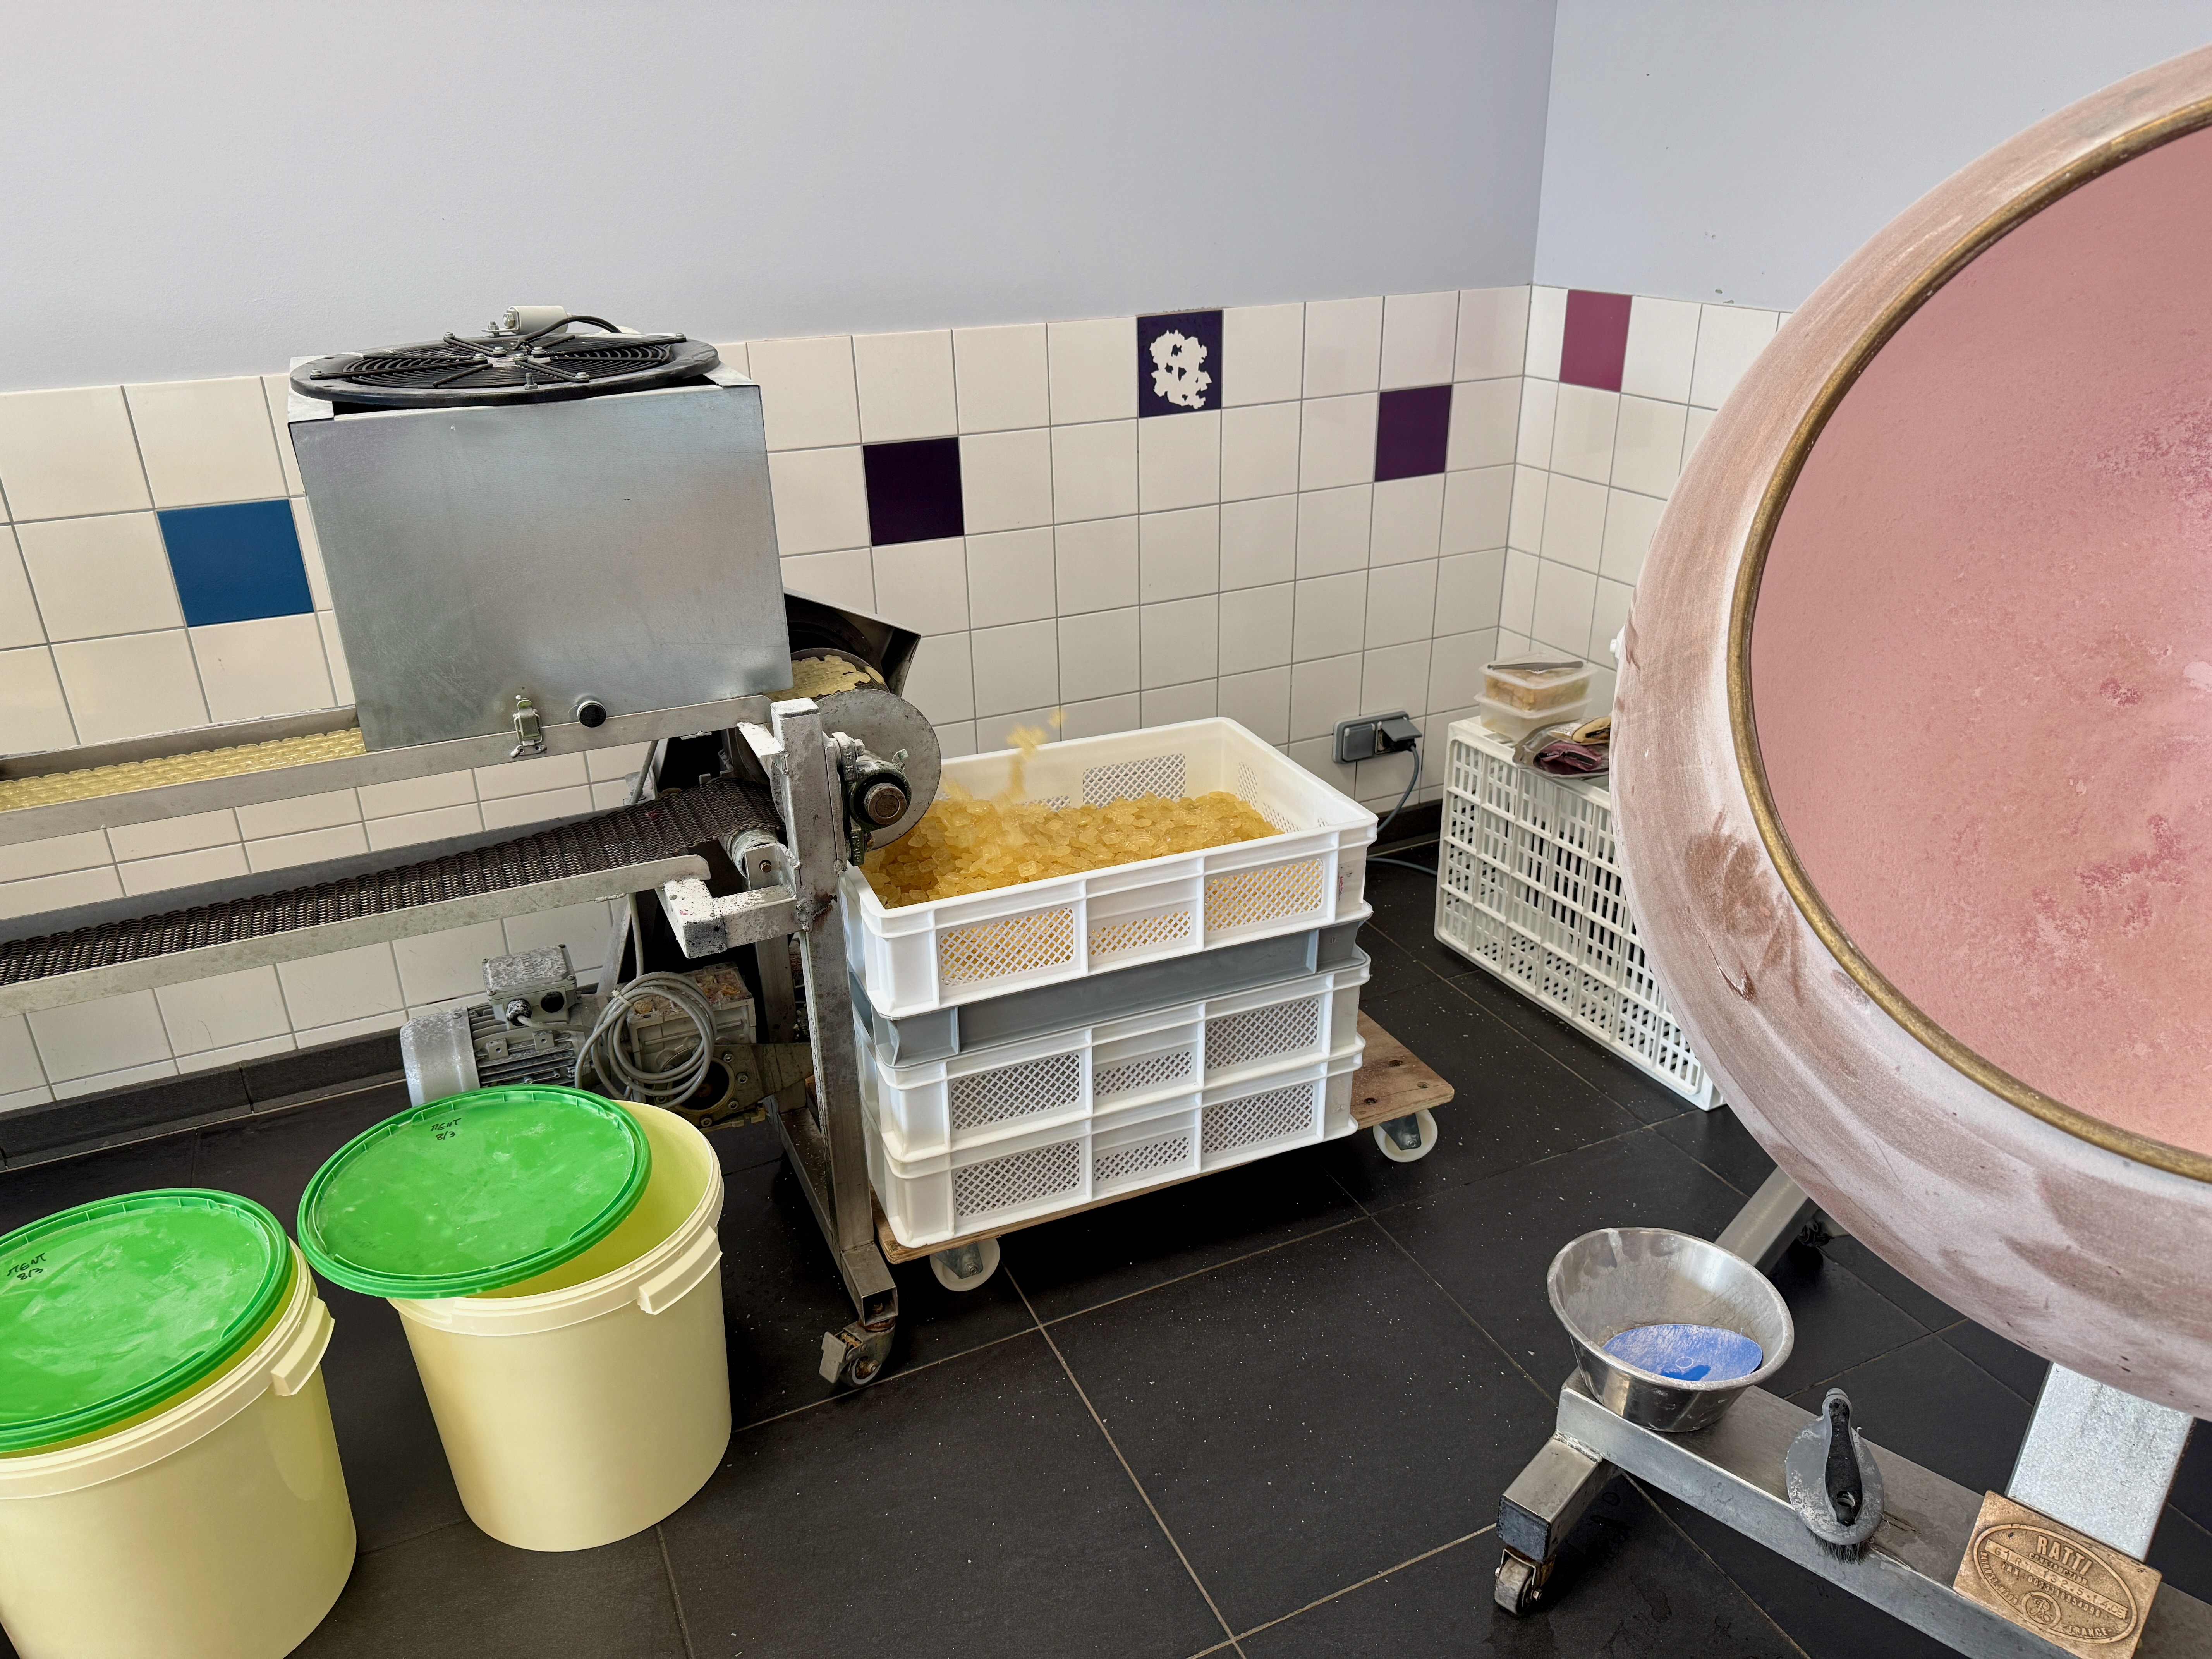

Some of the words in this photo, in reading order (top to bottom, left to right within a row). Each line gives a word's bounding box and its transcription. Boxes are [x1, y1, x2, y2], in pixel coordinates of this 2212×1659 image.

[436, 1131, 456, 1140] 8/3
[17, 1268, 43, 1280] 8/3
[2037, 1535, 2092, 1575] RATTI
[2002, 1562, 2020, 1577] FAX
